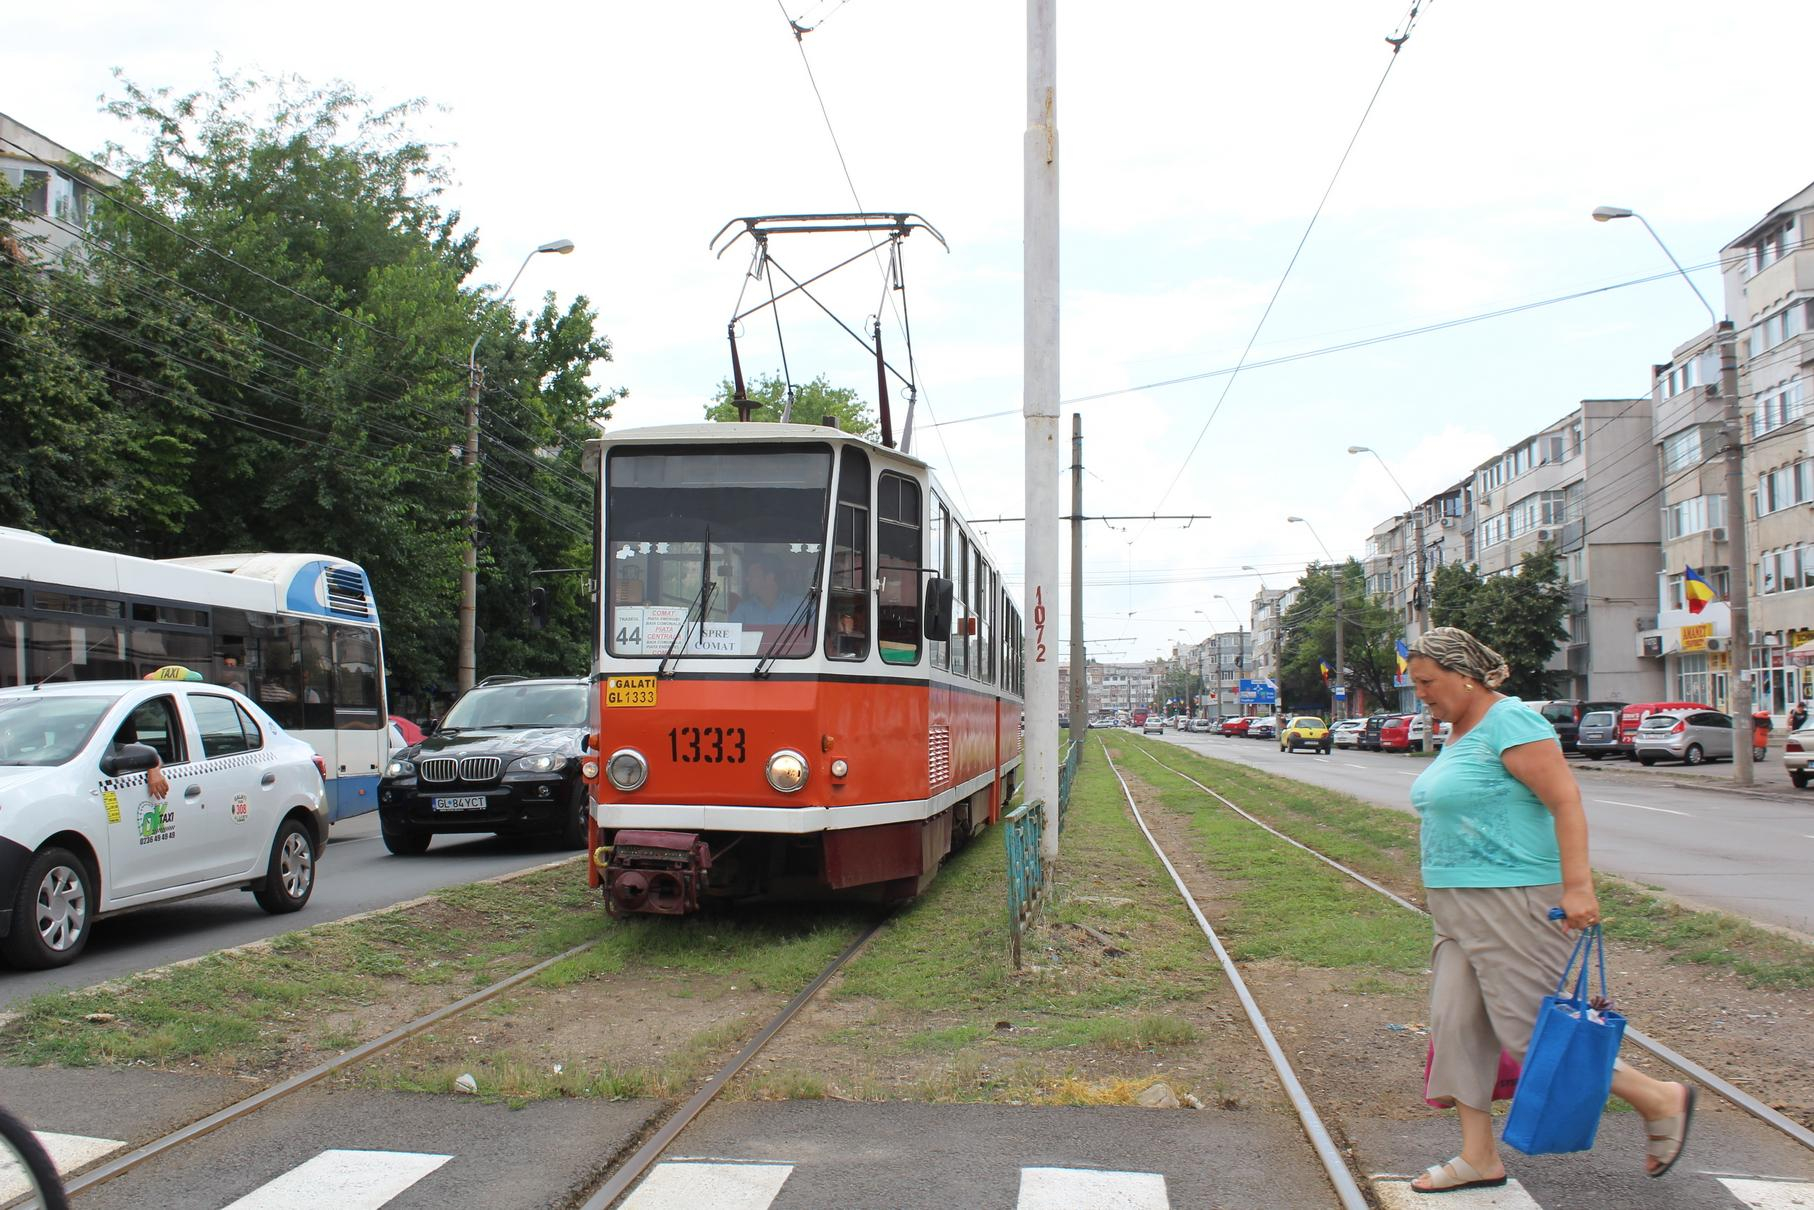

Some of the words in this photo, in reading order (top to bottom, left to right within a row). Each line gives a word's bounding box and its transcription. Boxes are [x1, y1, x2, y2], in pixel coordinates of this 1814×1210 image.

[1034, 585, 1046, 663] 1072
[615, 626, 642, 645] 44
[702, 629, 729, 639] SPRE
[694, 641, 737, 652] COMAT
[160, 667, 180, 679] TAXI
[616, 679, 655, 689] GALATI
[608, 692, 623, 703] GL
[625, 691, 654, 703] 1333
[668, 727, 746, 763] 1333
[235, 804, 247, 815] 308
[159, 811, 175, 824] TAXI
